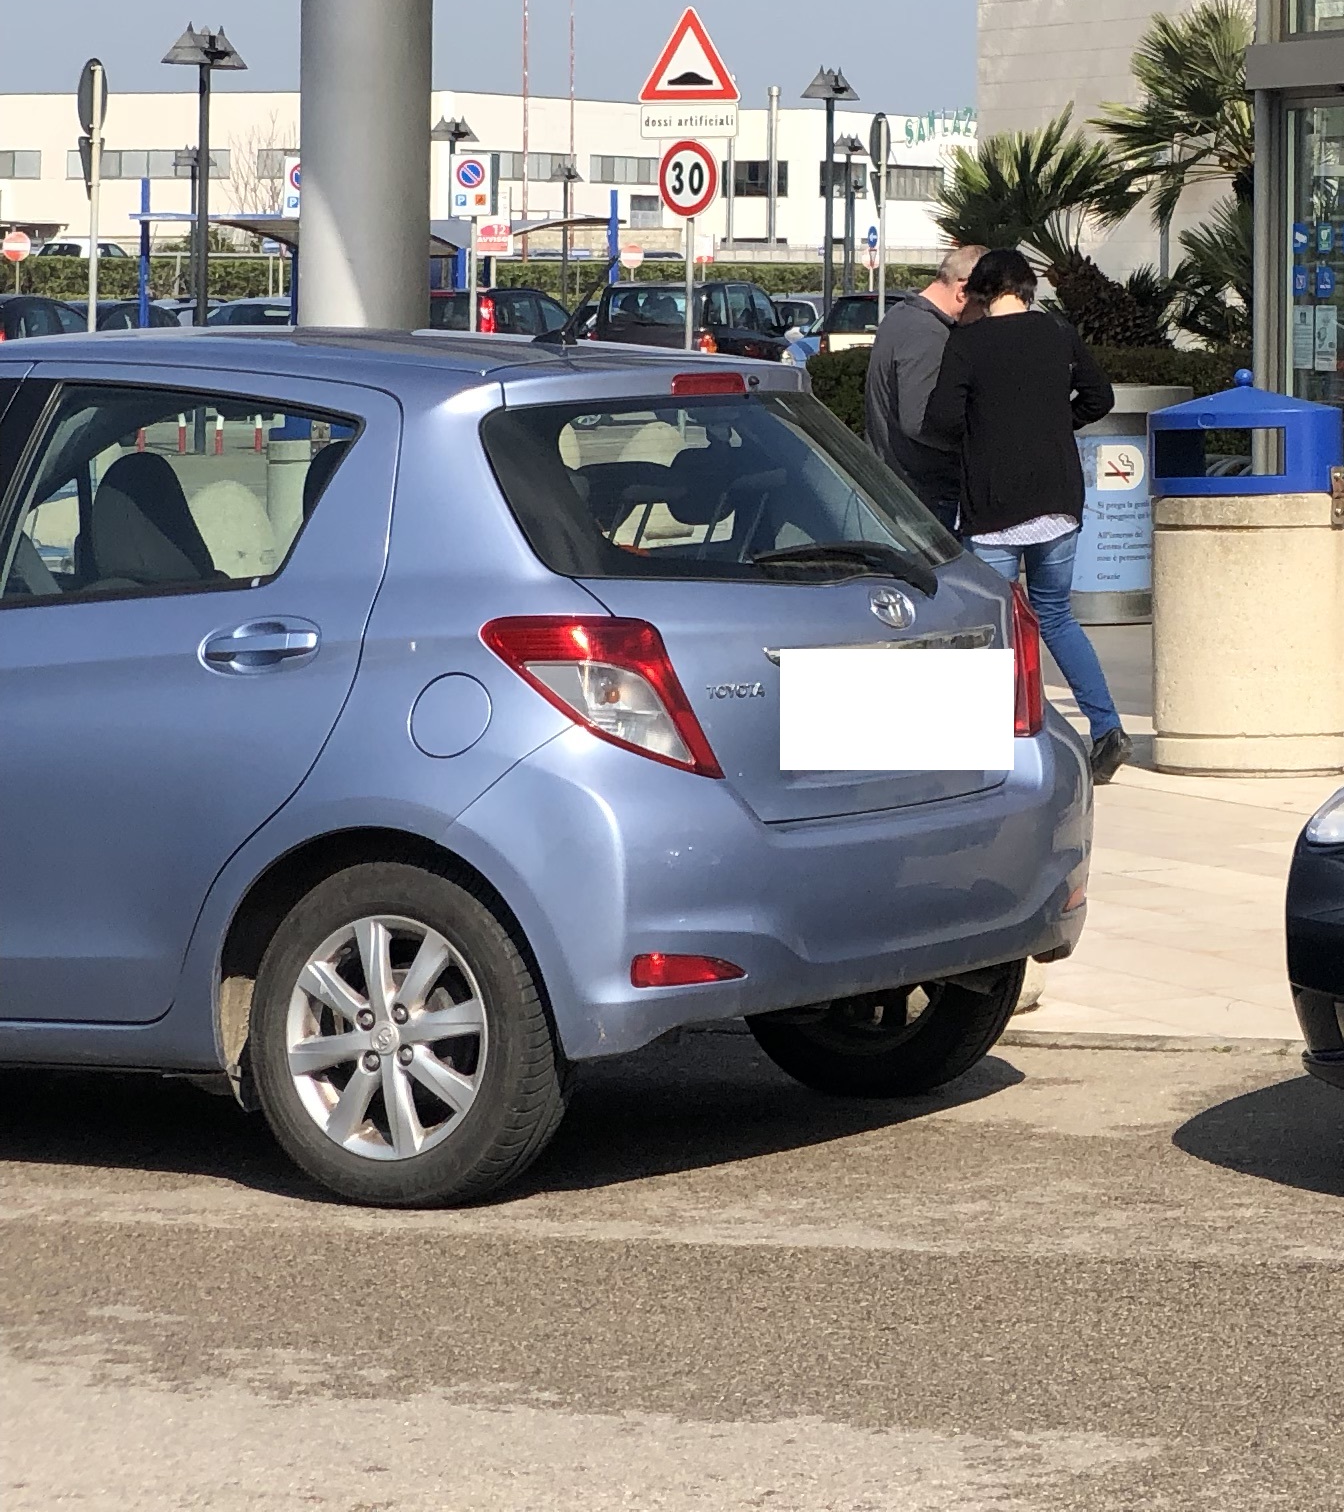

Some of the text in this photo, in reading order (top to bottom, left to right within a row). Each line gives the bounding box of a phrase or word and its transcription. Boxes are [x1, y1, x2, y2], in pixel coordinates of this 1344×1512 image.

[644, 115, 734, 127] dossi artificiali
[905, 106, 978, 148] SAN LAZ
[671, 161, 704, 196] 30
[493, 225, 506, 236] 12
[706, 683, 766, 699] TOYOTA
